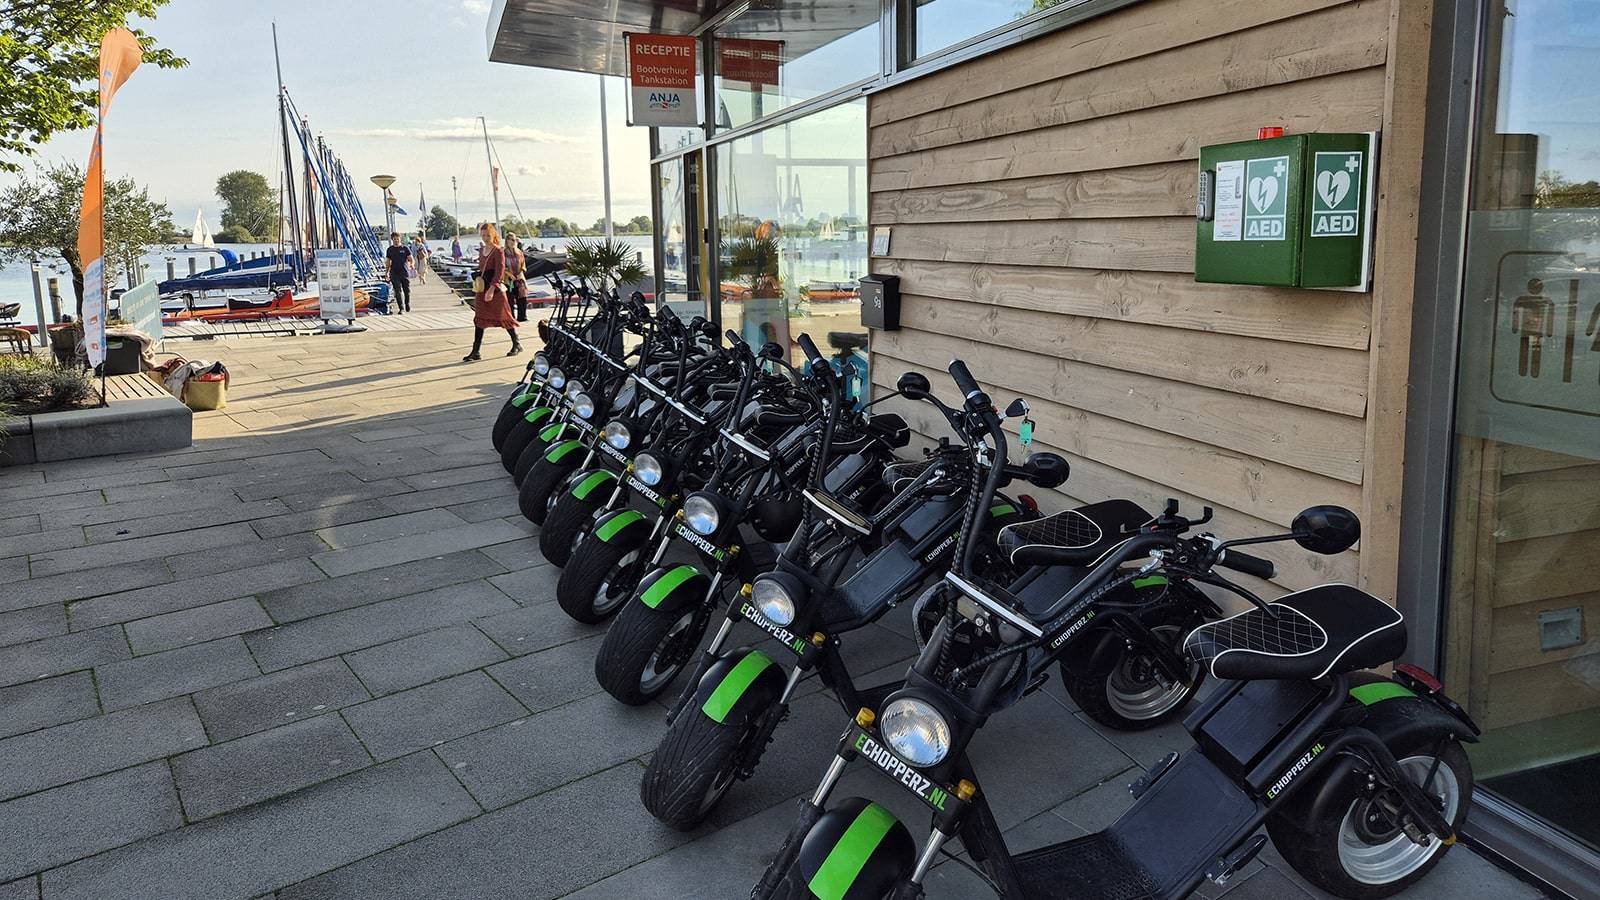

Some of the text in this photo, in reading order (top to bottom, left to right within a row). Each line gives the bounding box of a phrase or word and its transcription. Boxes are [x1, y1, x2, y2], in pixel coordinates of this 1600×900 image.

[636, 44, 690, 57] RECEPTIE
[637, 65, 688, 75] Bootverhuur
[640, 75, 688, 86] Tankstation
[650, 92, 680, 102] ANJA
[1248, 219, 1283, 237] AED
[1315, 215, 1355, 233] AED
[854, 733, 949, 811] ECHOPPERZ.NL
[1266, 743, 1325, 800] ECHOPPERZ.NL
